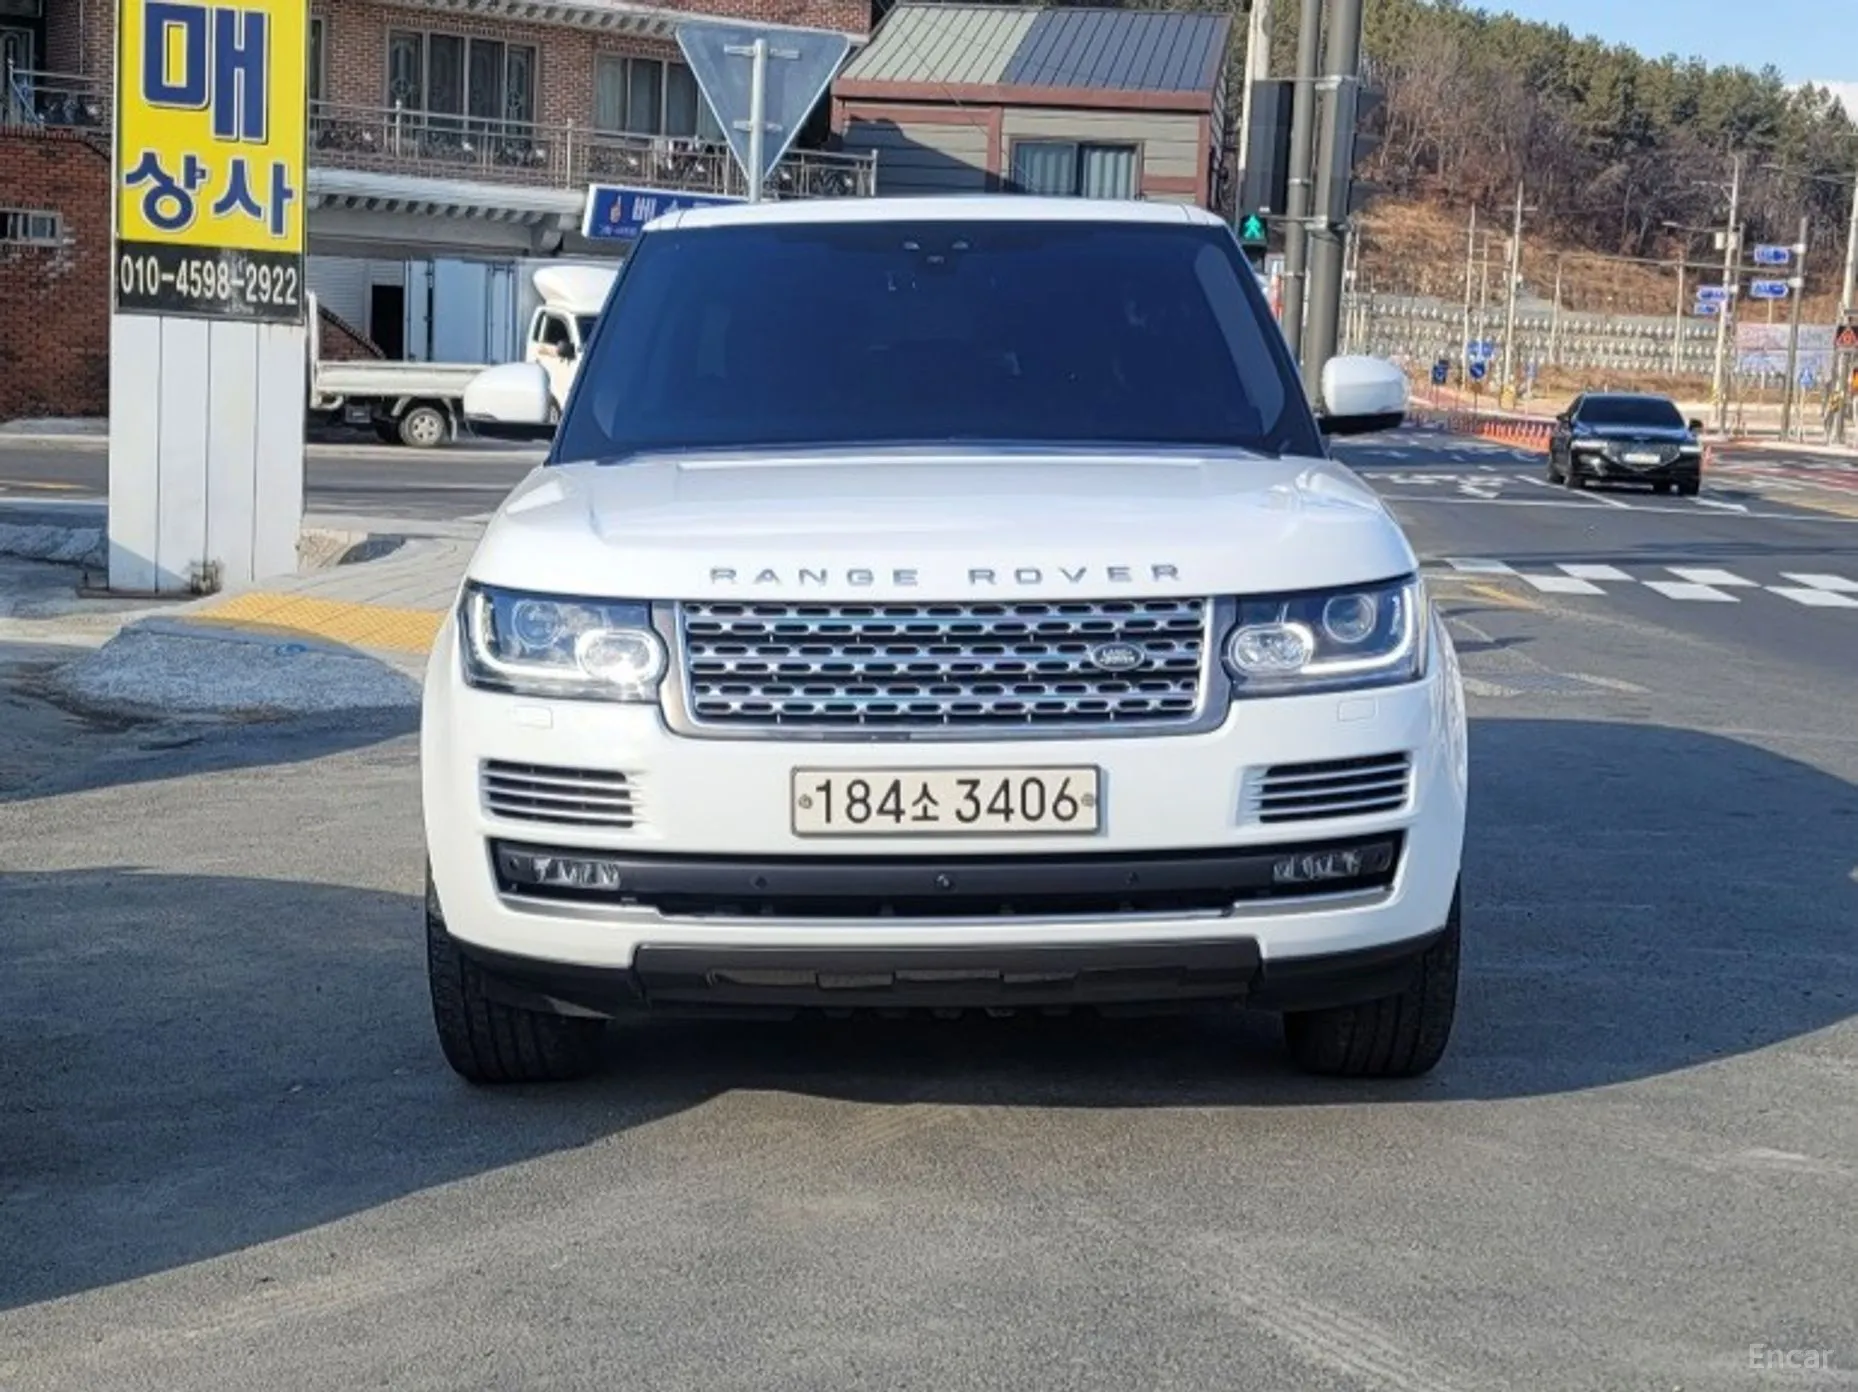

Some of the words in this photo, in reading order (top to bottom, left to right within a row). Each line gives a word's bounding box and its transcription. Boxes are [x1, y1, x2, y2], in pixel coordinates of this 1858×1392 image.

[142, 2, 268, 144] 매
[123, 150, 295, 238] 상사
[120, 255, 298, 305] 010-4598-2922
[709, 568, 919, 586] RANGE
[968, 564, 1181, 585] ROVER
[814, 778, 940, 824] 184소
[954, 777, 1079, 822] 3406
